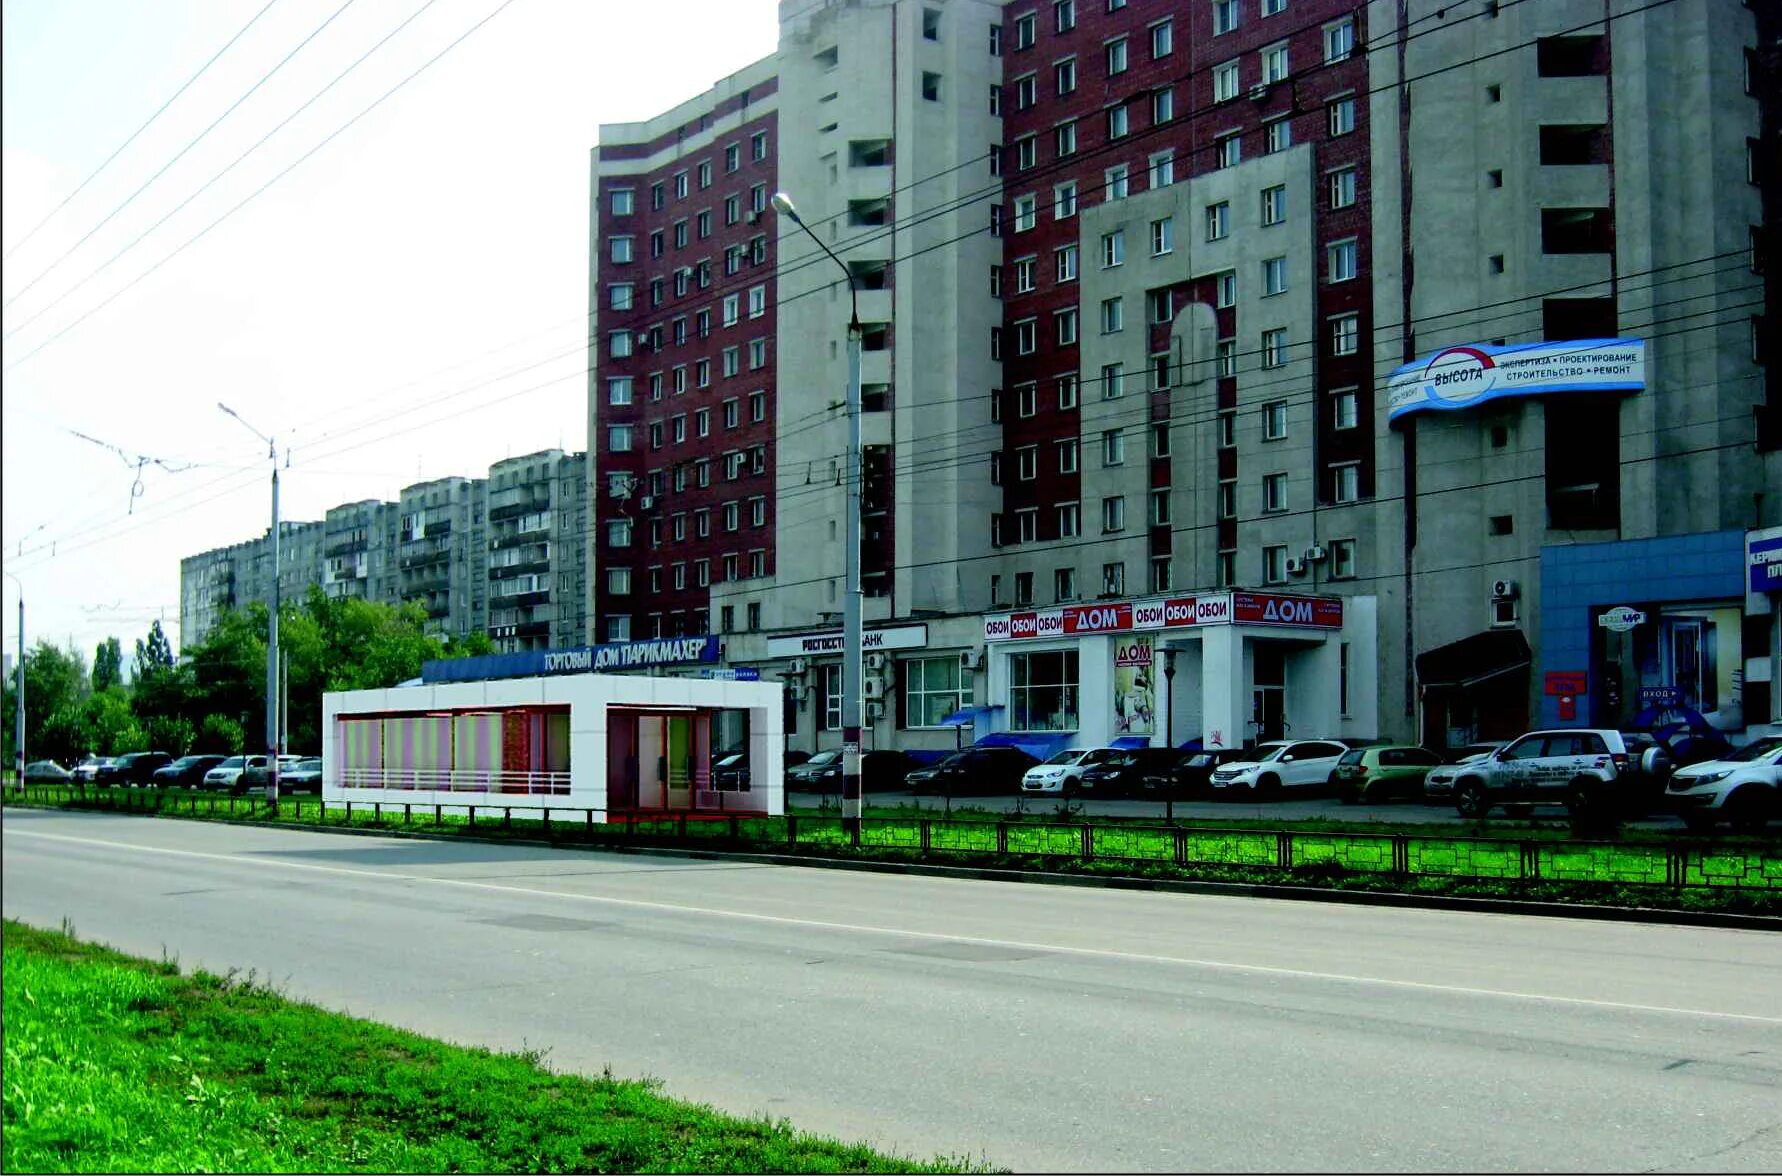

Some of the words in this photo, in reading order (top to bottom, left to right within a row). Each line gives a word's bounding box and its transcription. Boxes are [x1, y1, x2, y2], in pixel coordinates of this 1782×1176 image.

[1500, 356, 1551, 369] ЭКСПЕРТИЗА
[1560, 353, 1637, 364] ПРОЕКТИРОВАНИЕ
[1435, 367, 1483, 386] ВЫСОТА
[1506, 368, 1583, 380] СТРОИТЕЛЬСТВО
[1594, 365, 1631, 375] РЕМОНТ
[986, 620, 1009, 635] ОБОИ
[1011, 617, 1036, 633] ОБОИ
[1038, 616, 1062, 631] ОБОИ
[1076, 608, 1118, 630] ДОМ
[1136, 607, 1163, 623] ОБОИ
[1166, 604, 1194, 620] ОБОИ
[1199, 601, 1227, 617] ОБОИ
[1263, 599, 1313, 622] ДОМ
[544, 647, 592, 671] ТОРГОВЫЙ
[594, 647, 619, 670] ДОМ
[1118, 645, 1151, 661] ДОМ
